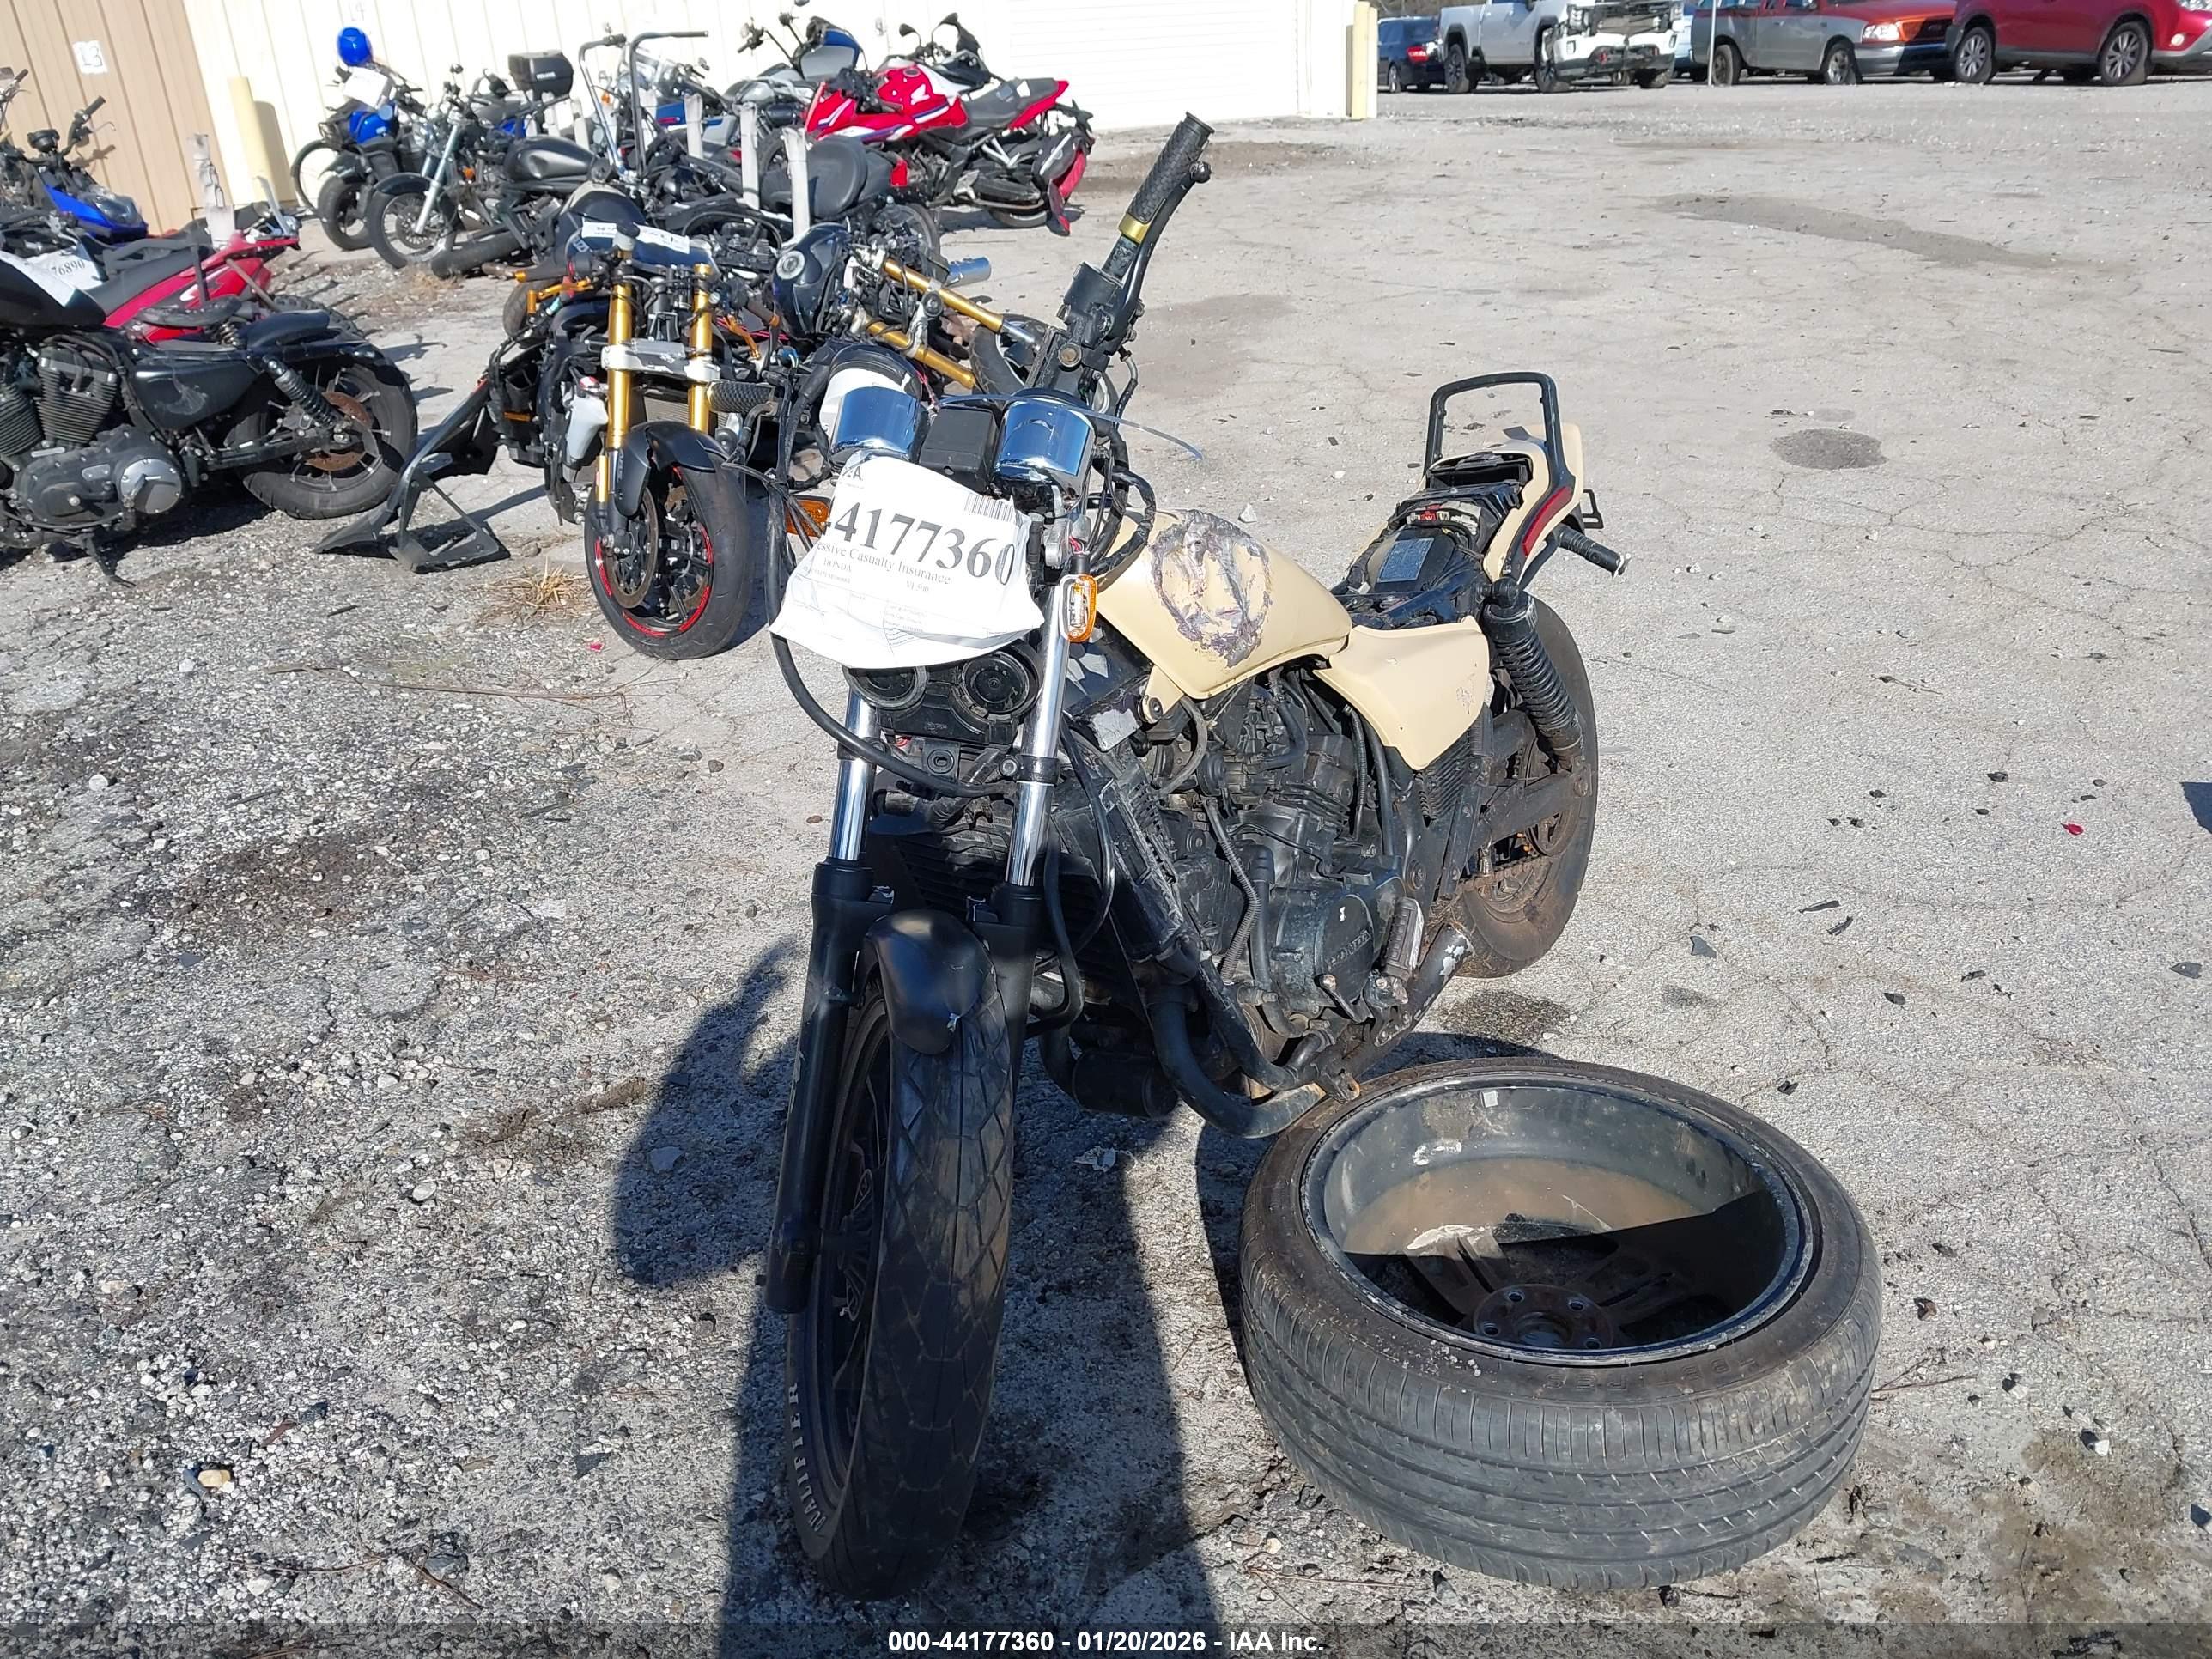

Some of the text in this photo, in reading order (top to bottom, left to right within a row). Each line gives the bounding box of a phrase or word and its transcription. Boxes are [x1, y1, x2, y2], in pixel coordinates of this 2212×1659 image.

[825, 501, 1016, 586] 4177360
[849, 548, 895, 572] Casualty
[898, 560, 951, 585] Insurance
[788, 1382, 826, 1532] QUALIFIER
